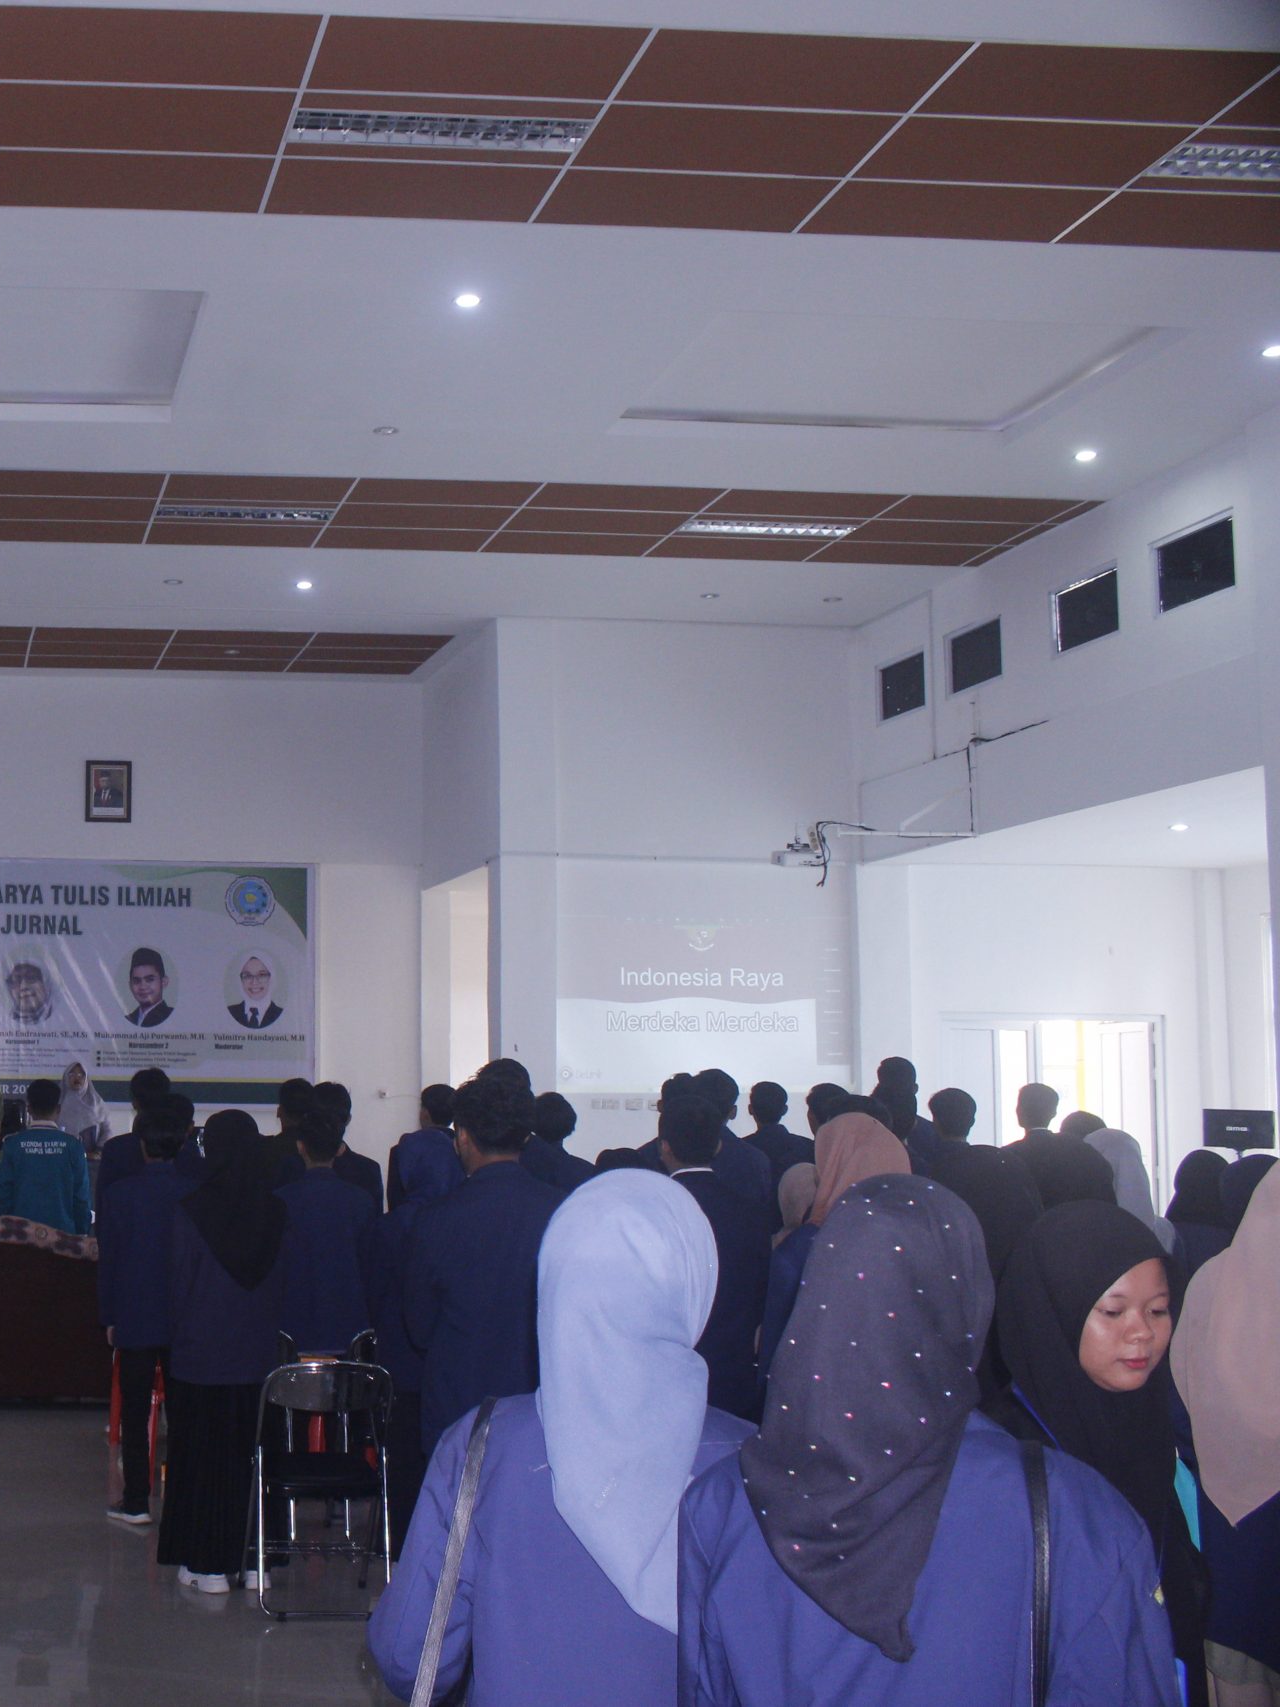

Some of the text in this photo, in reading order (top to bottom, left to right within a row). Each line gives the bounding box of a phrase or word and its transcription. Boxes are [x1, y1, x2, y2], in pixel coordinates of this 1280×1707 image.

[51, 885, 110, 906] TULIS
[117, 886, 191, 907] ILMIAH
[1, 914, 83, 935] JURNAL
[619, 966, 784, 991] Indonesia Raya
[606, 1010, 799, 1032] Merdeka Merdeka
[94, 1031, 138, 1039] Muhammad
